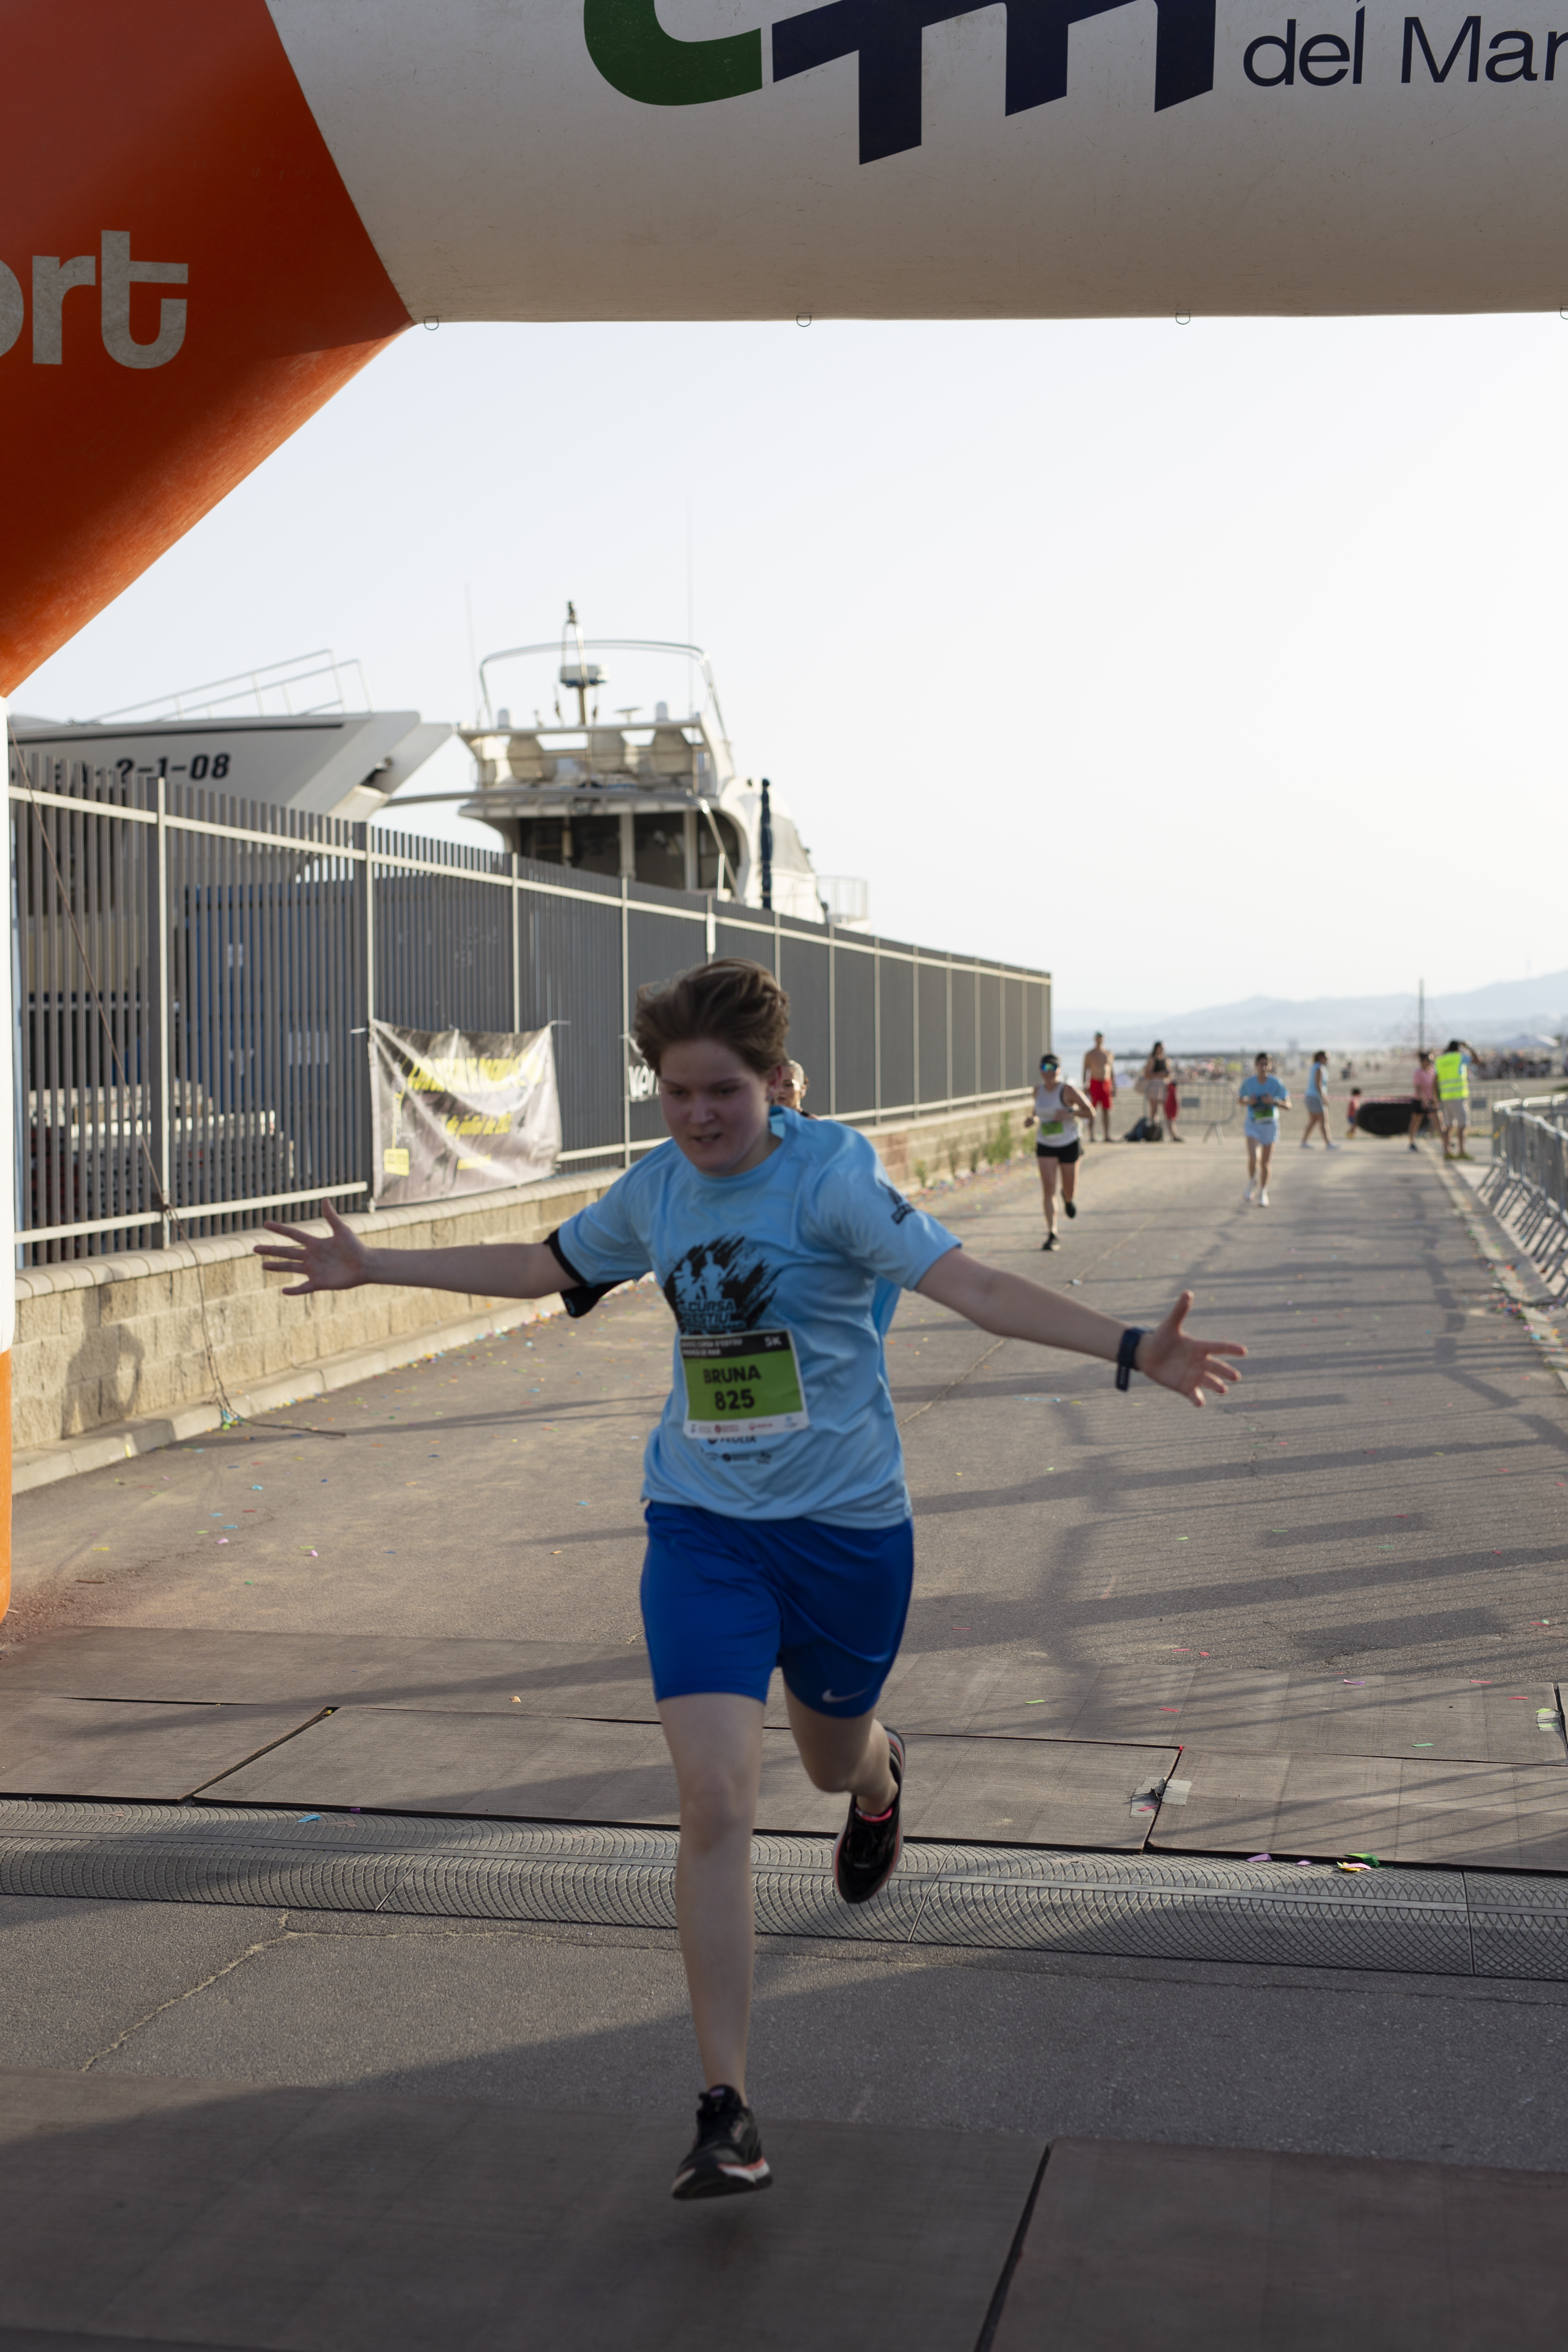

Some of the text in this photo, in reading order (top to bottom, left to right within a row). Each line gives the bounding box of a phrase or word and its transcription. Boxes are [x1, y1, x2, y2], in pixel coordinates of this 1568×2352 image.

[1243, 5, 1366, 87] del
[0, 230, 189, 369] rt
[764, 1336, 782, 1348] 5K
[703, 1365, 762, 1384] BRUNA
[715, 1389, 755, 1411] 825
